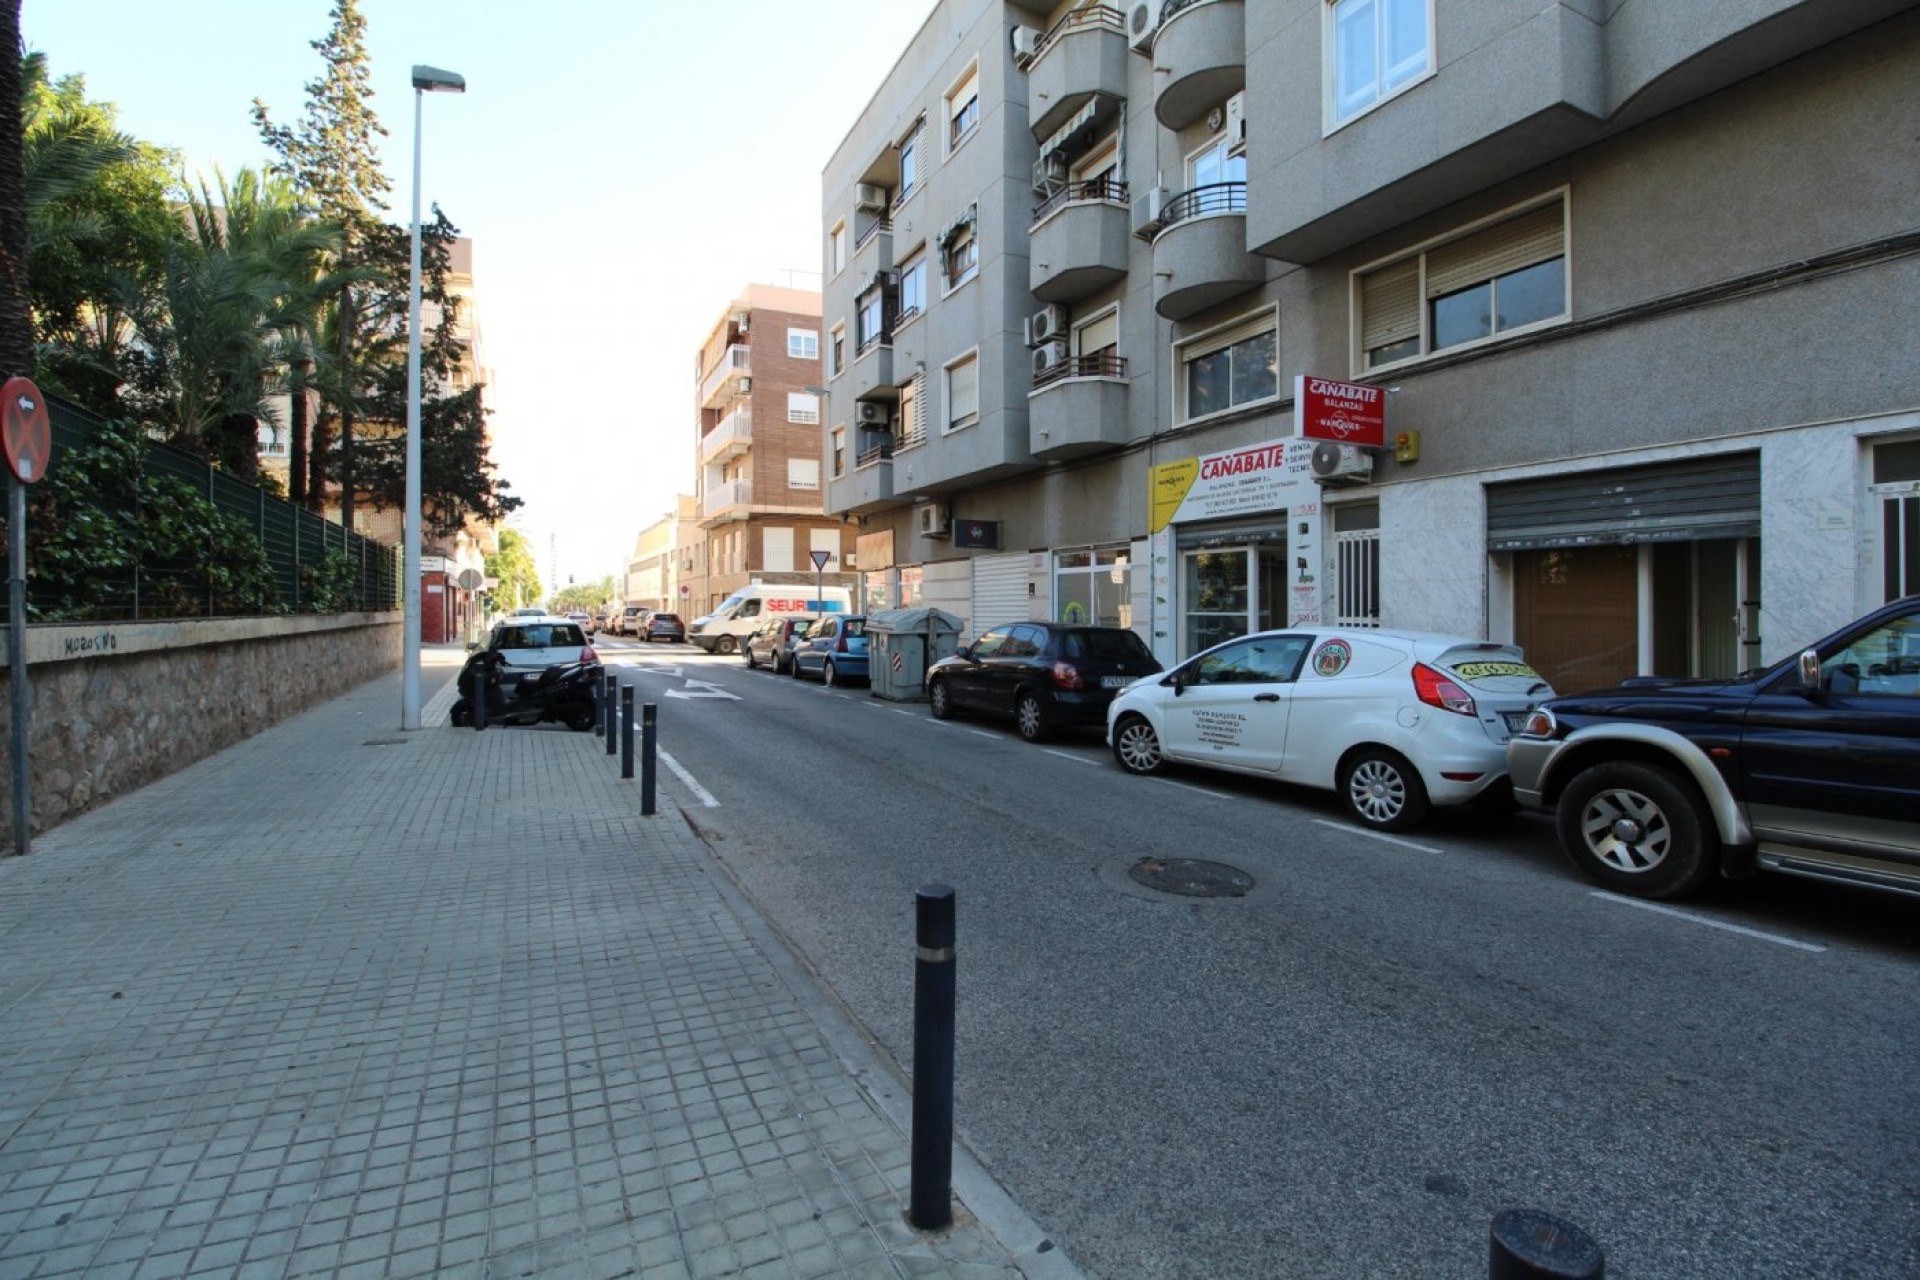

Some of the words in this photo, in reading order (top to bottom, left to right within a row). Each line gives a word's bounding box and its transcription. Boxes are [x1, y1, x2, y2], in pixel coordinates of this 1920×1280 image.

[1309, 379, 1377, 403] CAÑABATE
[1324, 398, 1364, 411] BALANZAS
[1290, 442, 1311, 453] VENTA
[1201, 443, 1284, 480] CAÑABATE
[767, 599, 806, 613] SEUR
